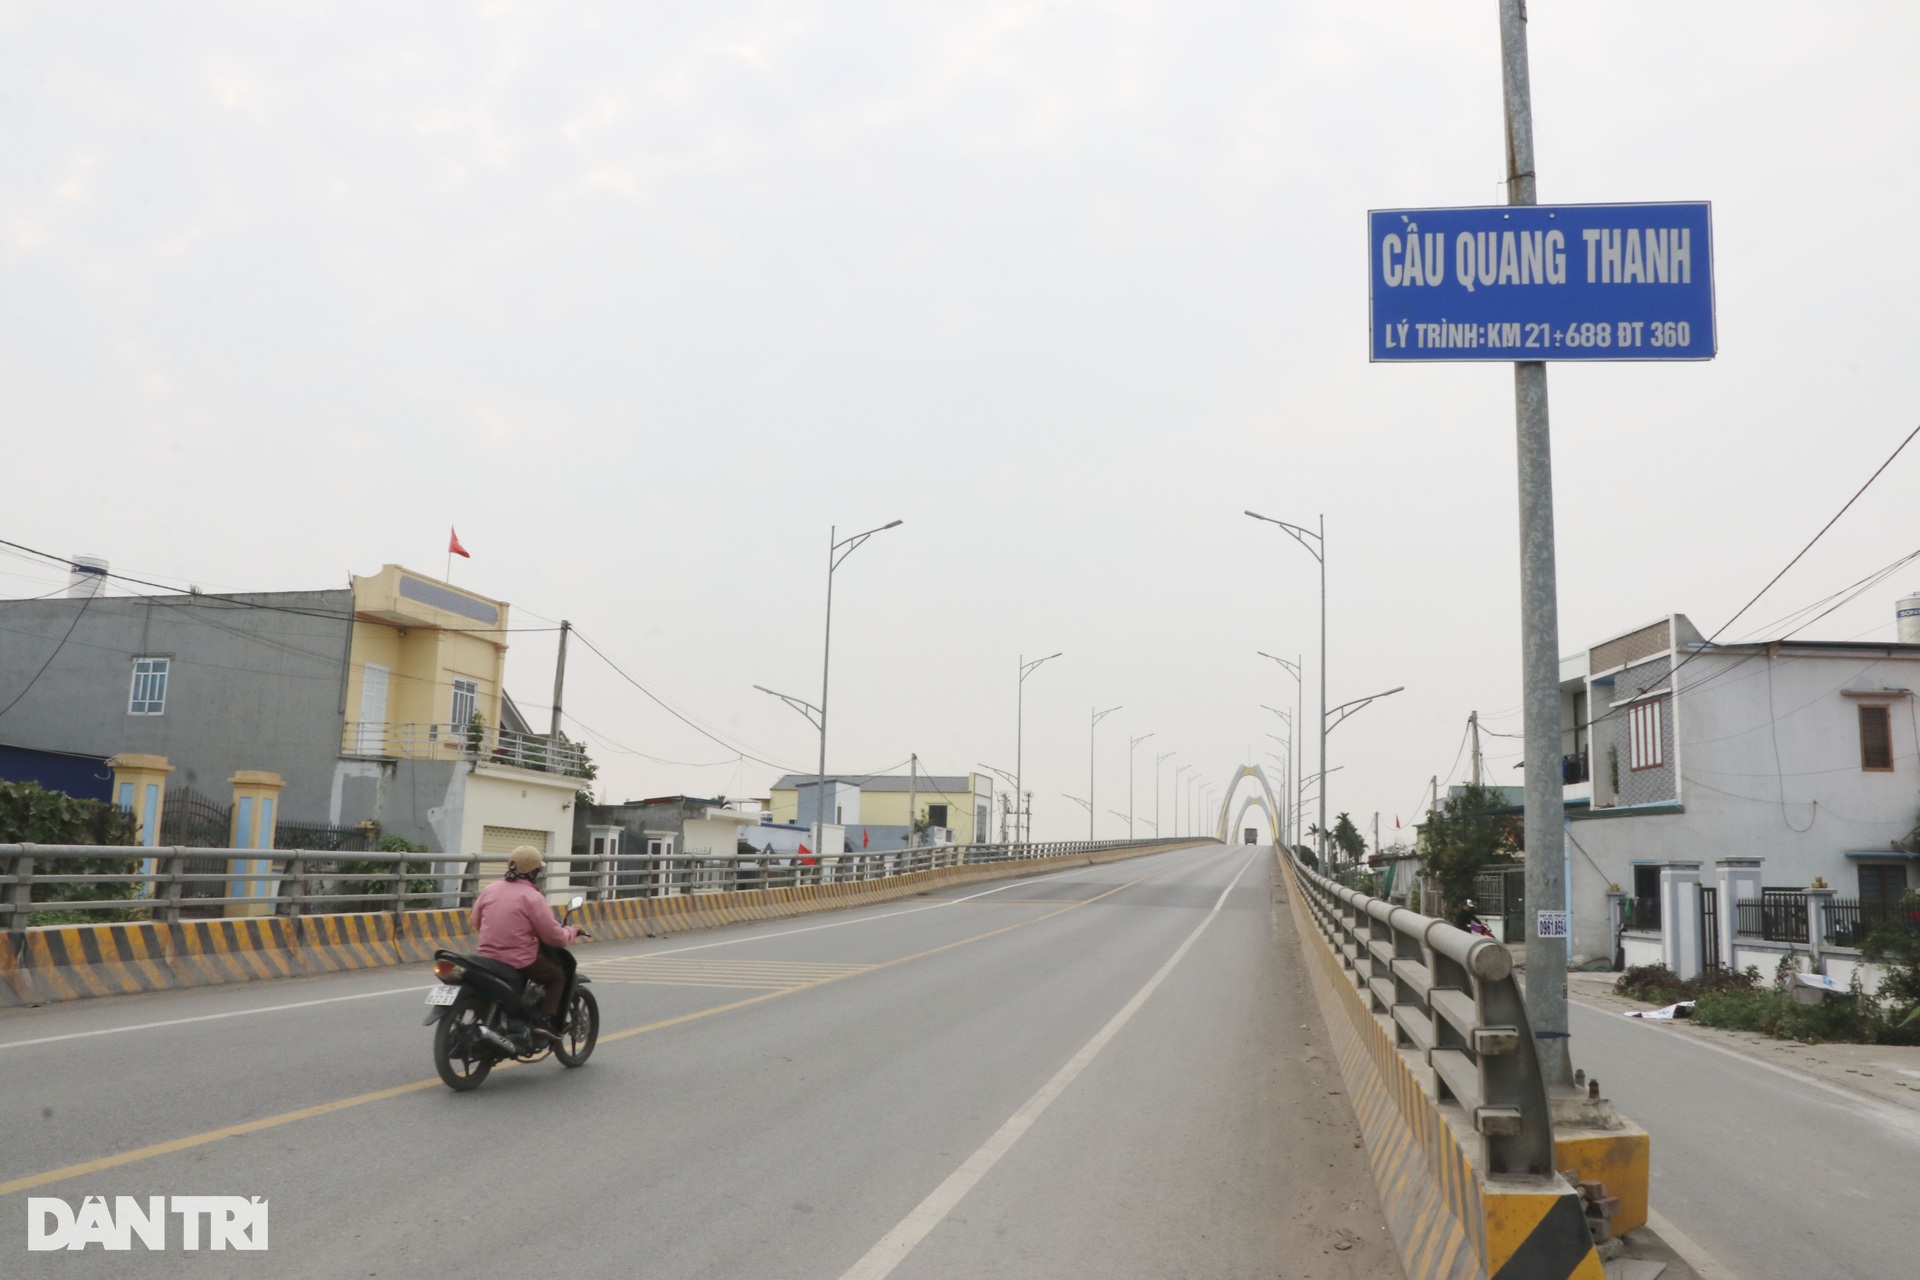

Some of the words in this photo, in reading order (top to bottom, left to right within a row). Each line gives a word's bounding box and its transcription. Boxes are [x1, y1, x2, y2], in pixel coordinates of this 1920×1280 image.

[1383, 215, 1444, 288] CẦU
[1456, 229, 1566, 292] QUANG
[1582, 228, 1691, 284] THANH
[1385, 318, 1410, 348] LÝ
[1617, 321, 1644, 347] ĐT
[1650, 321, 1690, 347] 360
